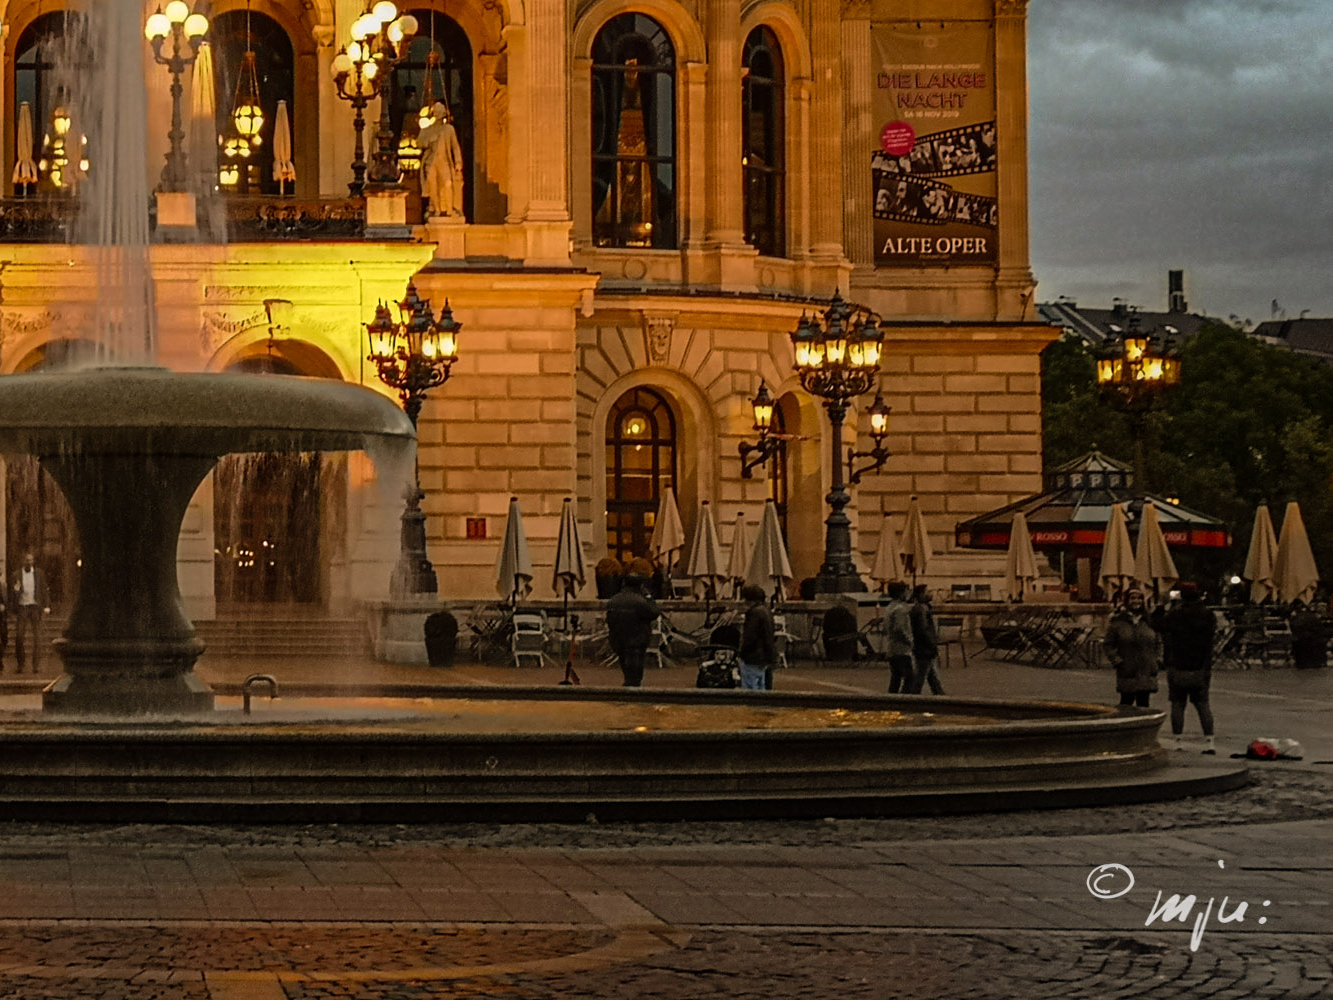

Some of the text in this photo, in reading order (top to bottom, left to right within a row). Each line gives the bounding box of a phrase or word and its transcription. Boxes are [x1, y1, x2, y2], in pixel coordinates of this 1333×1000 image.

[877, 71, 987, 89] DIE LANGE
[897, 90, 968, 109] NACHT
[882, 236, 988, 254] ALTE OPER
[1036, 531, 1067, 541] ROSSO
